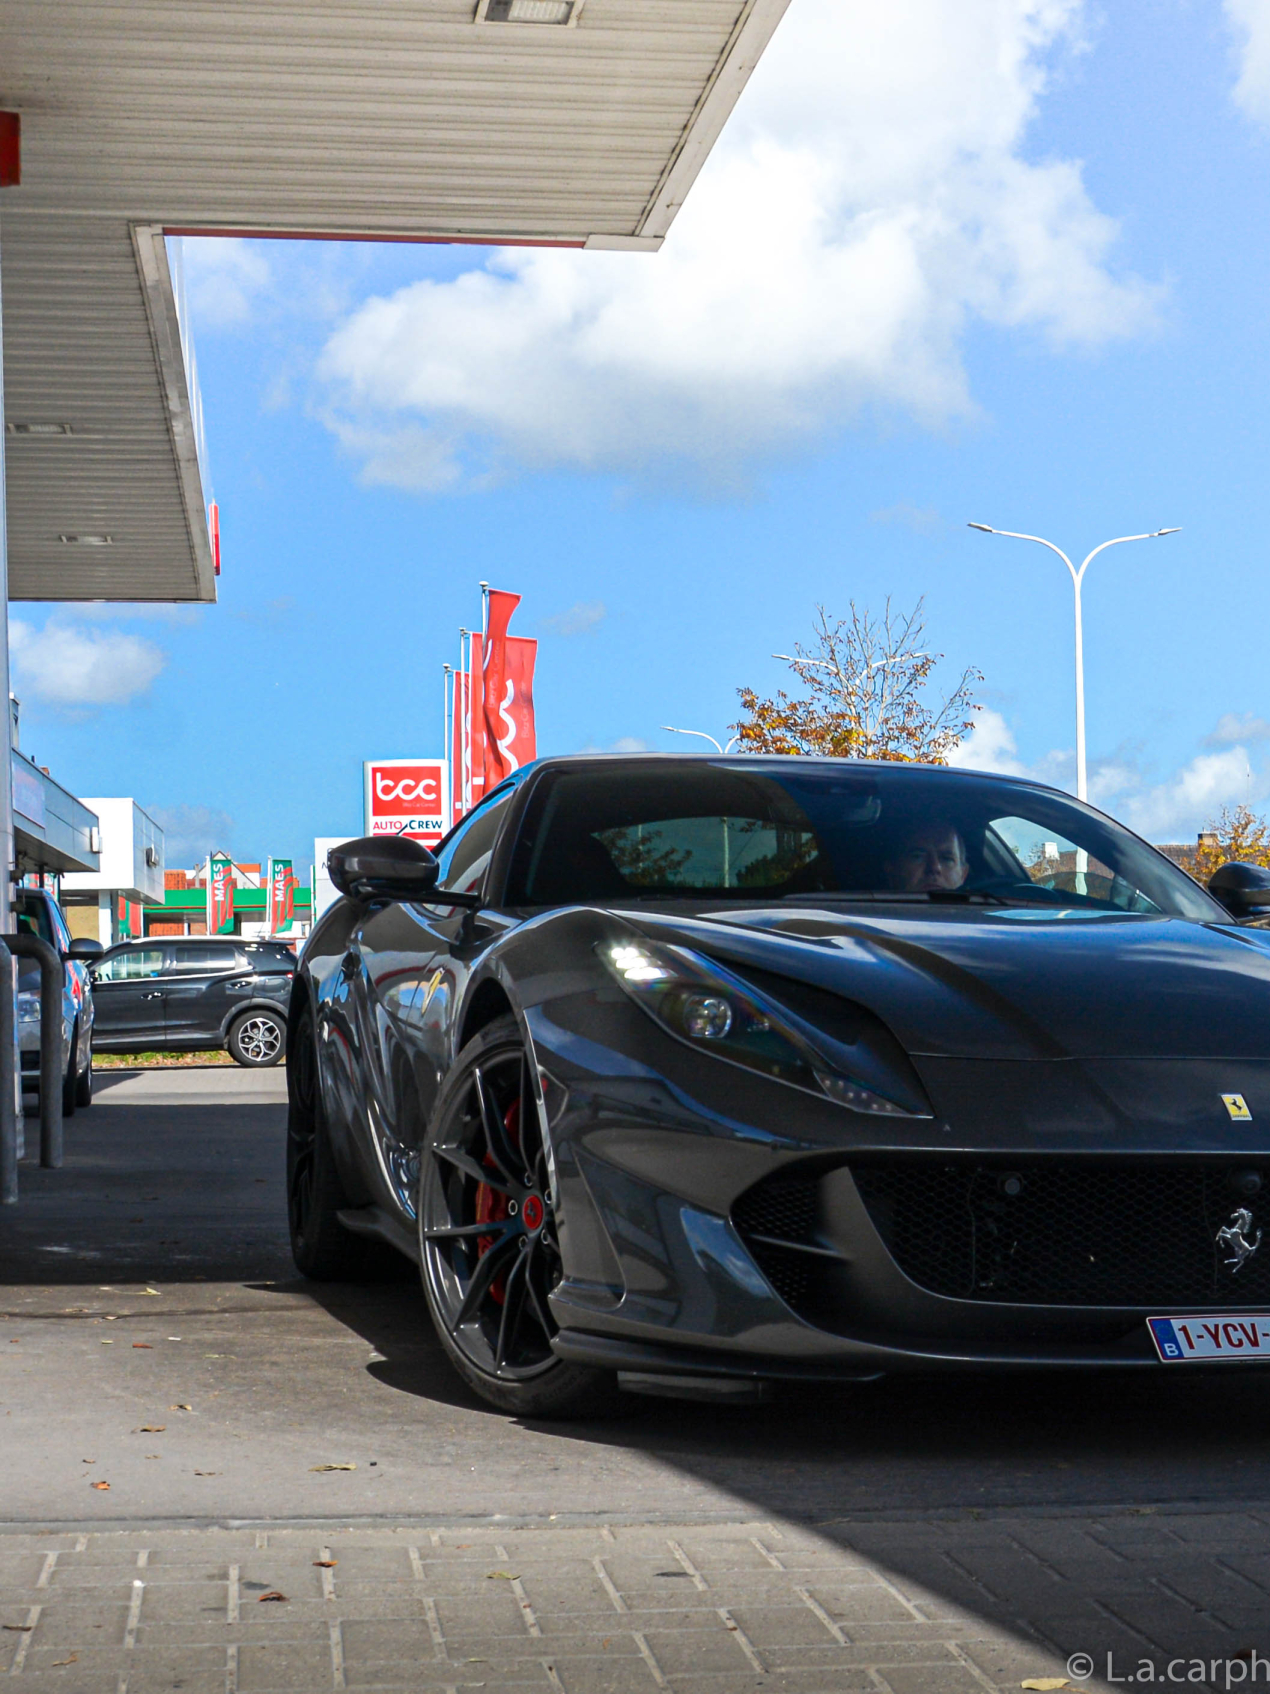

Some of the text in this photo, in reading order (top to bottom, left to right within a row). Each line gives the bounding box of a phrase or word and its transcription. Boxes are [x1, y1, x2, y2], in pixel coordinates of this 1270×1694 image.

[376, 772, 437, 801] bcc
[408, 820, 443, 830] CREW
[213, 863, 225, 901] MAES
[275, 864, 285, 901] MAES
[1164, 1343, 1179, 1356] B
